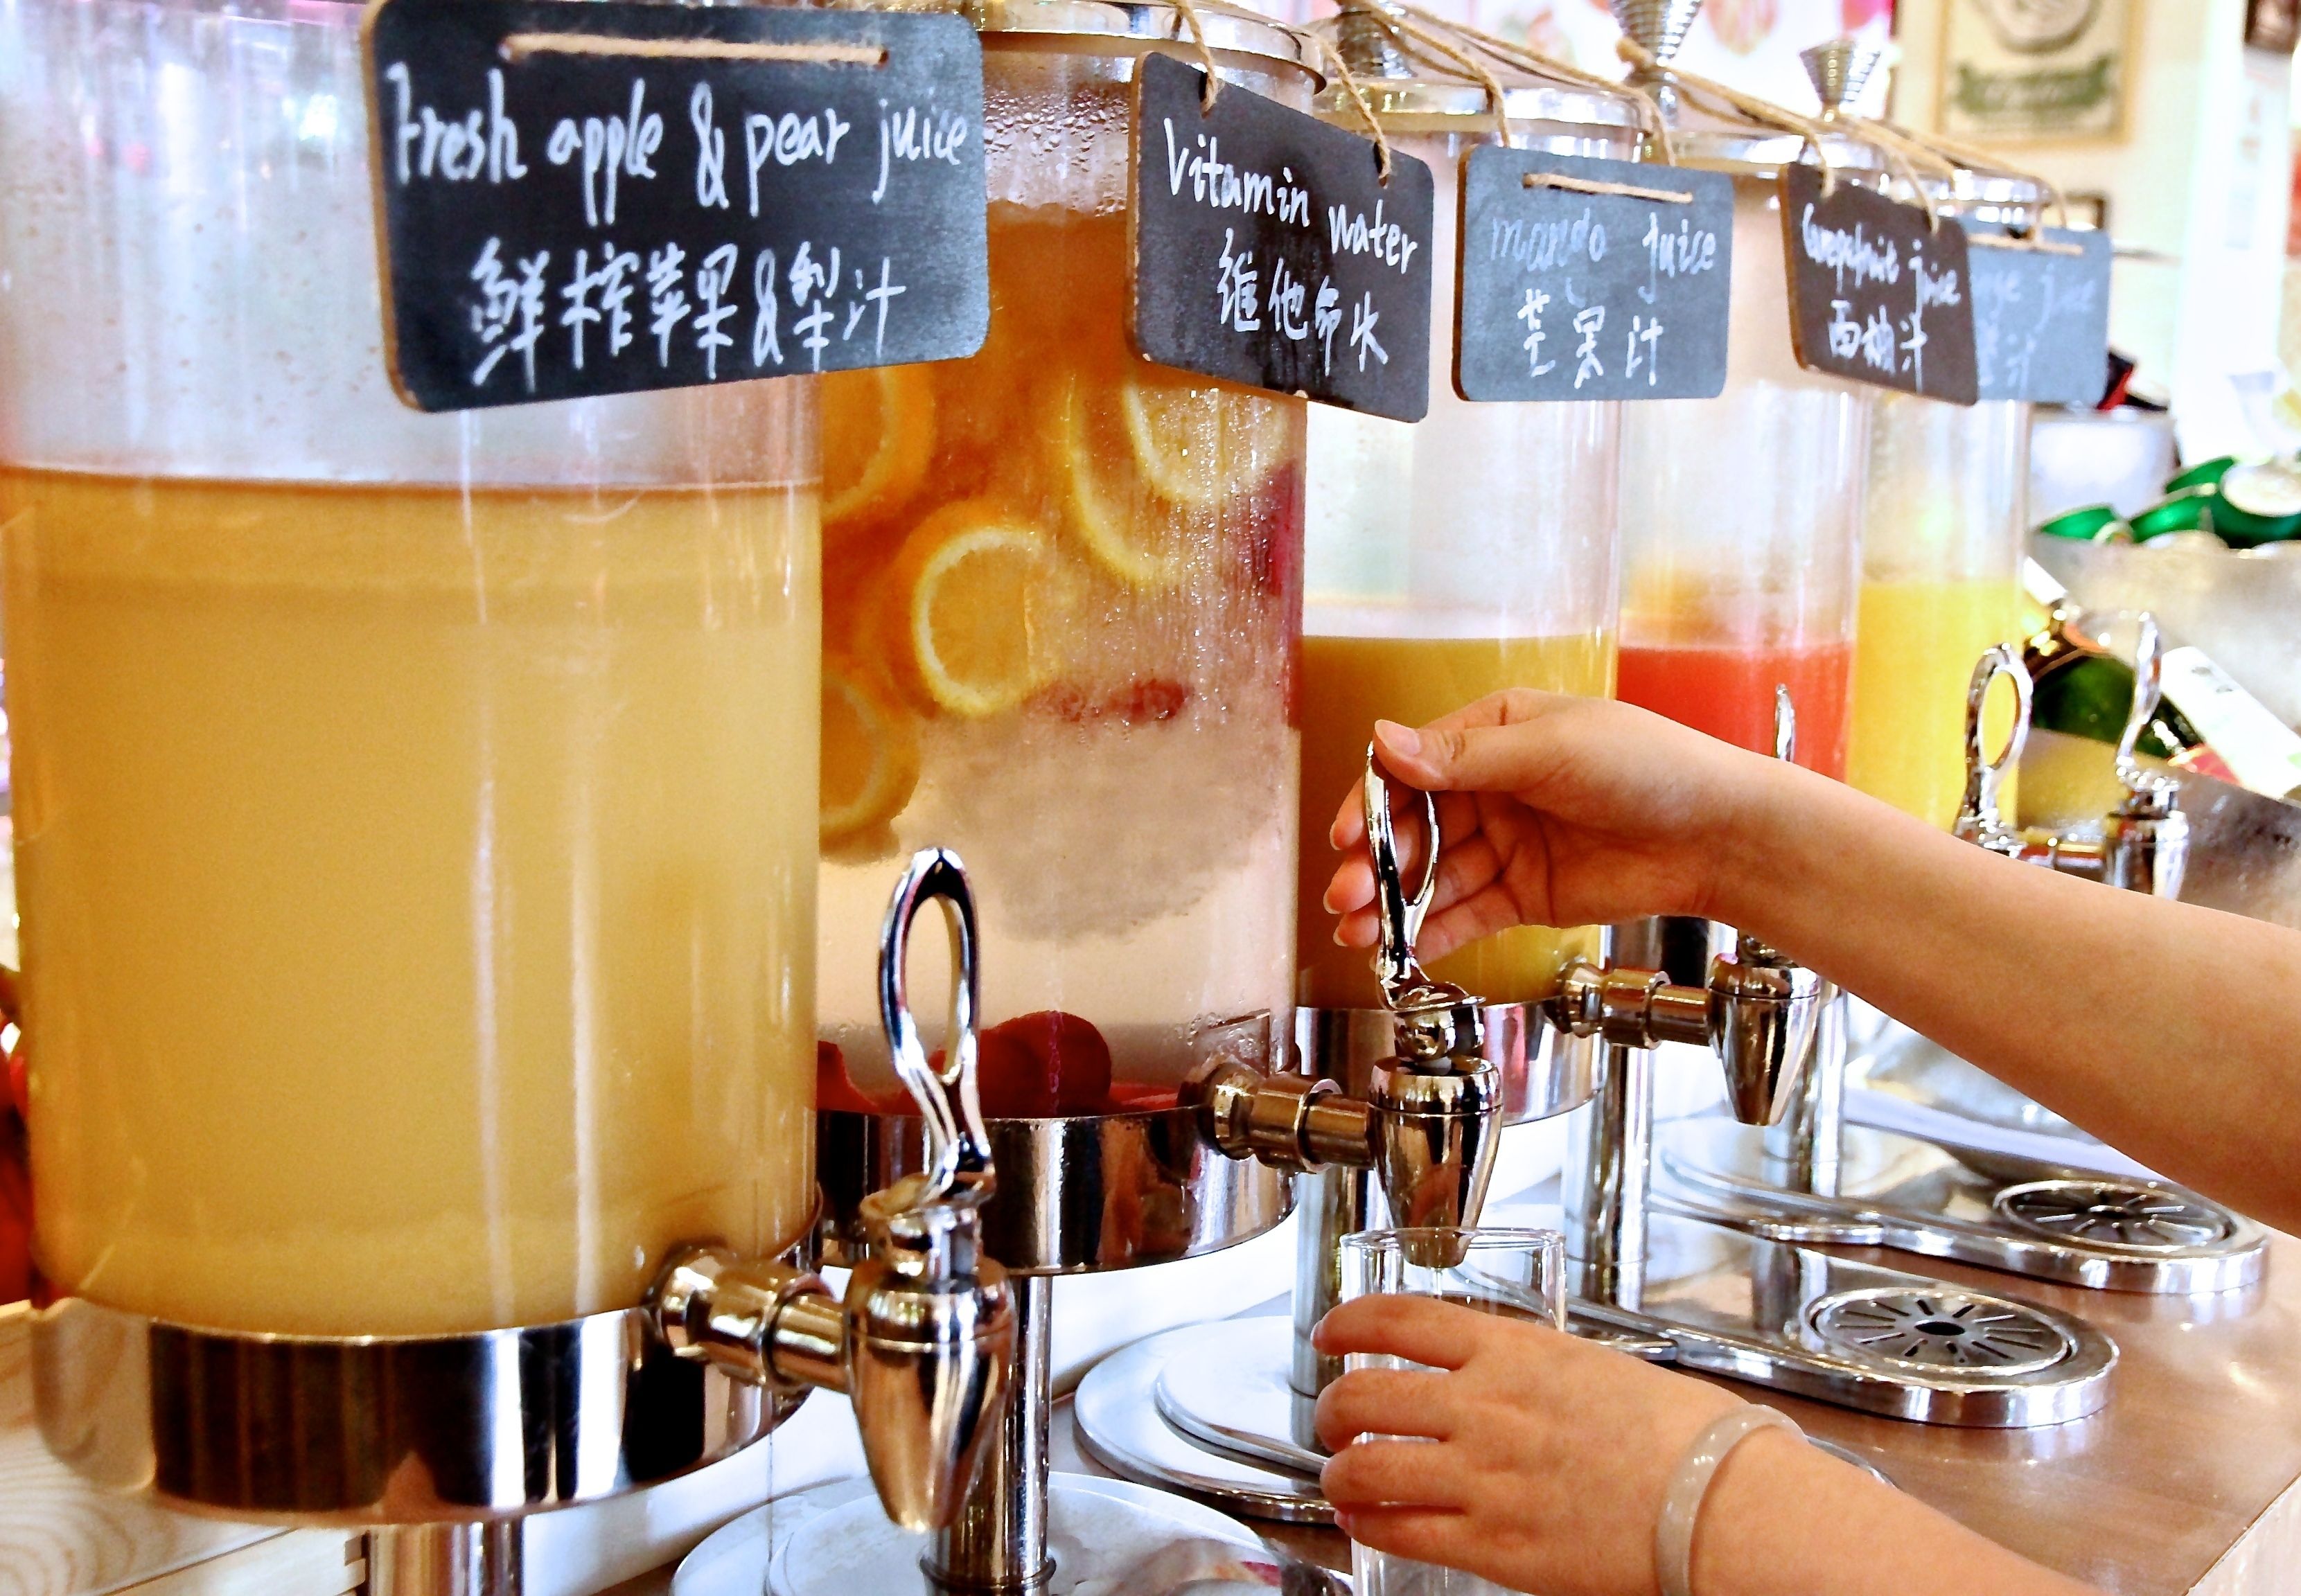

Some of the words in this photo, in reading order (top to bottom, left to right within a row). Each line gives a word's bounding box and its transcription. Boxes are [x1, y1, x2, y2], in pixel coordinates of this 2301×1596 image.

[547, 78, 664, 227] apple
[693, 80, 730, 211] &
[746, 109, 851, 218] pear
[872, 97, 967, 203] juice
